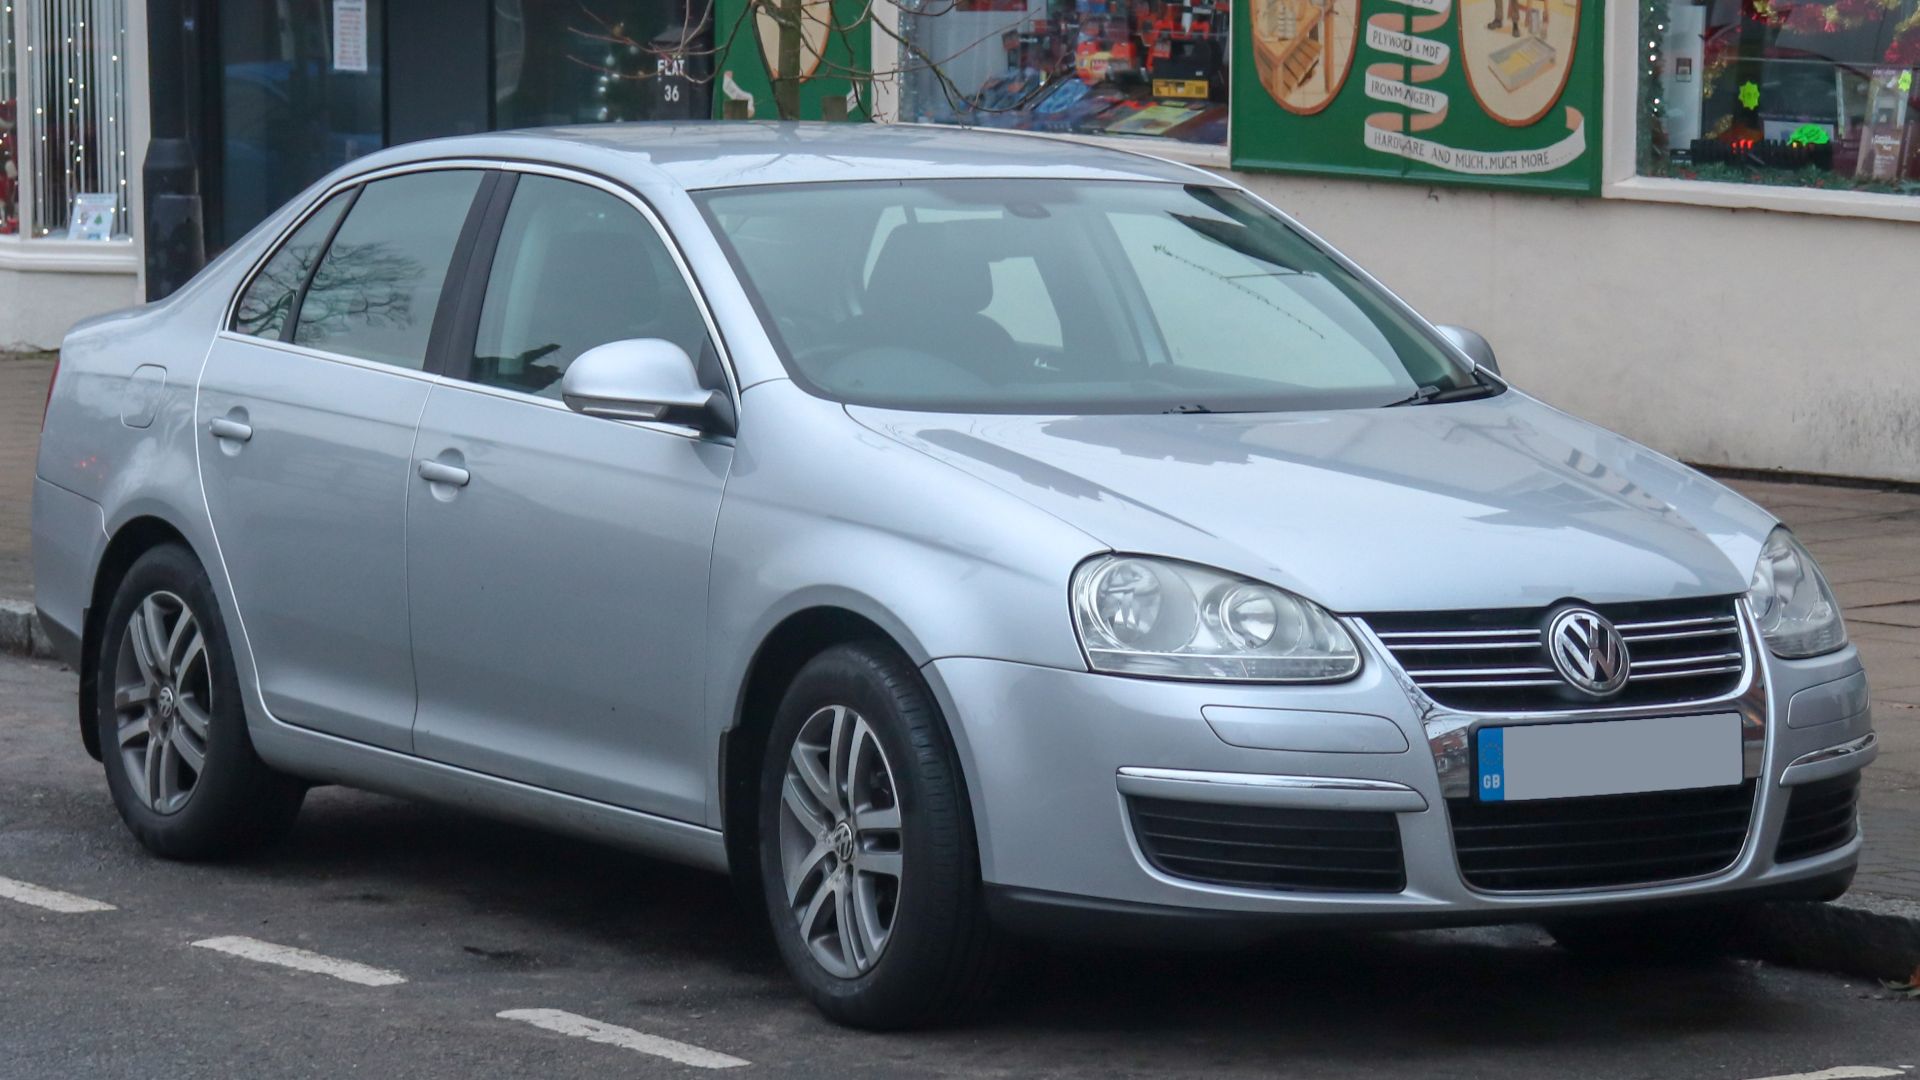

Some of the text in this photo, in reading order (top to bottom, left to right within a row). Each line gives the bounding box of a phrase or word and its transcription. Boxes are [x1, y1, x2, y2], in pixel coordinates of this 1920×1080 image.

[1422, 43, 1441, 59] MDF
[657, 59, 685, 76] FLAT
[664, 84, 680, 102] 36
[1371, 80, 1437, 108] IRONMNGERY
[1431, 147, 1451, 164] AND
[1489, 155, 1518, 170] MUCH
[1552, 611, 1625, 692] VW
[1483, 774, 1501, 789] GB
